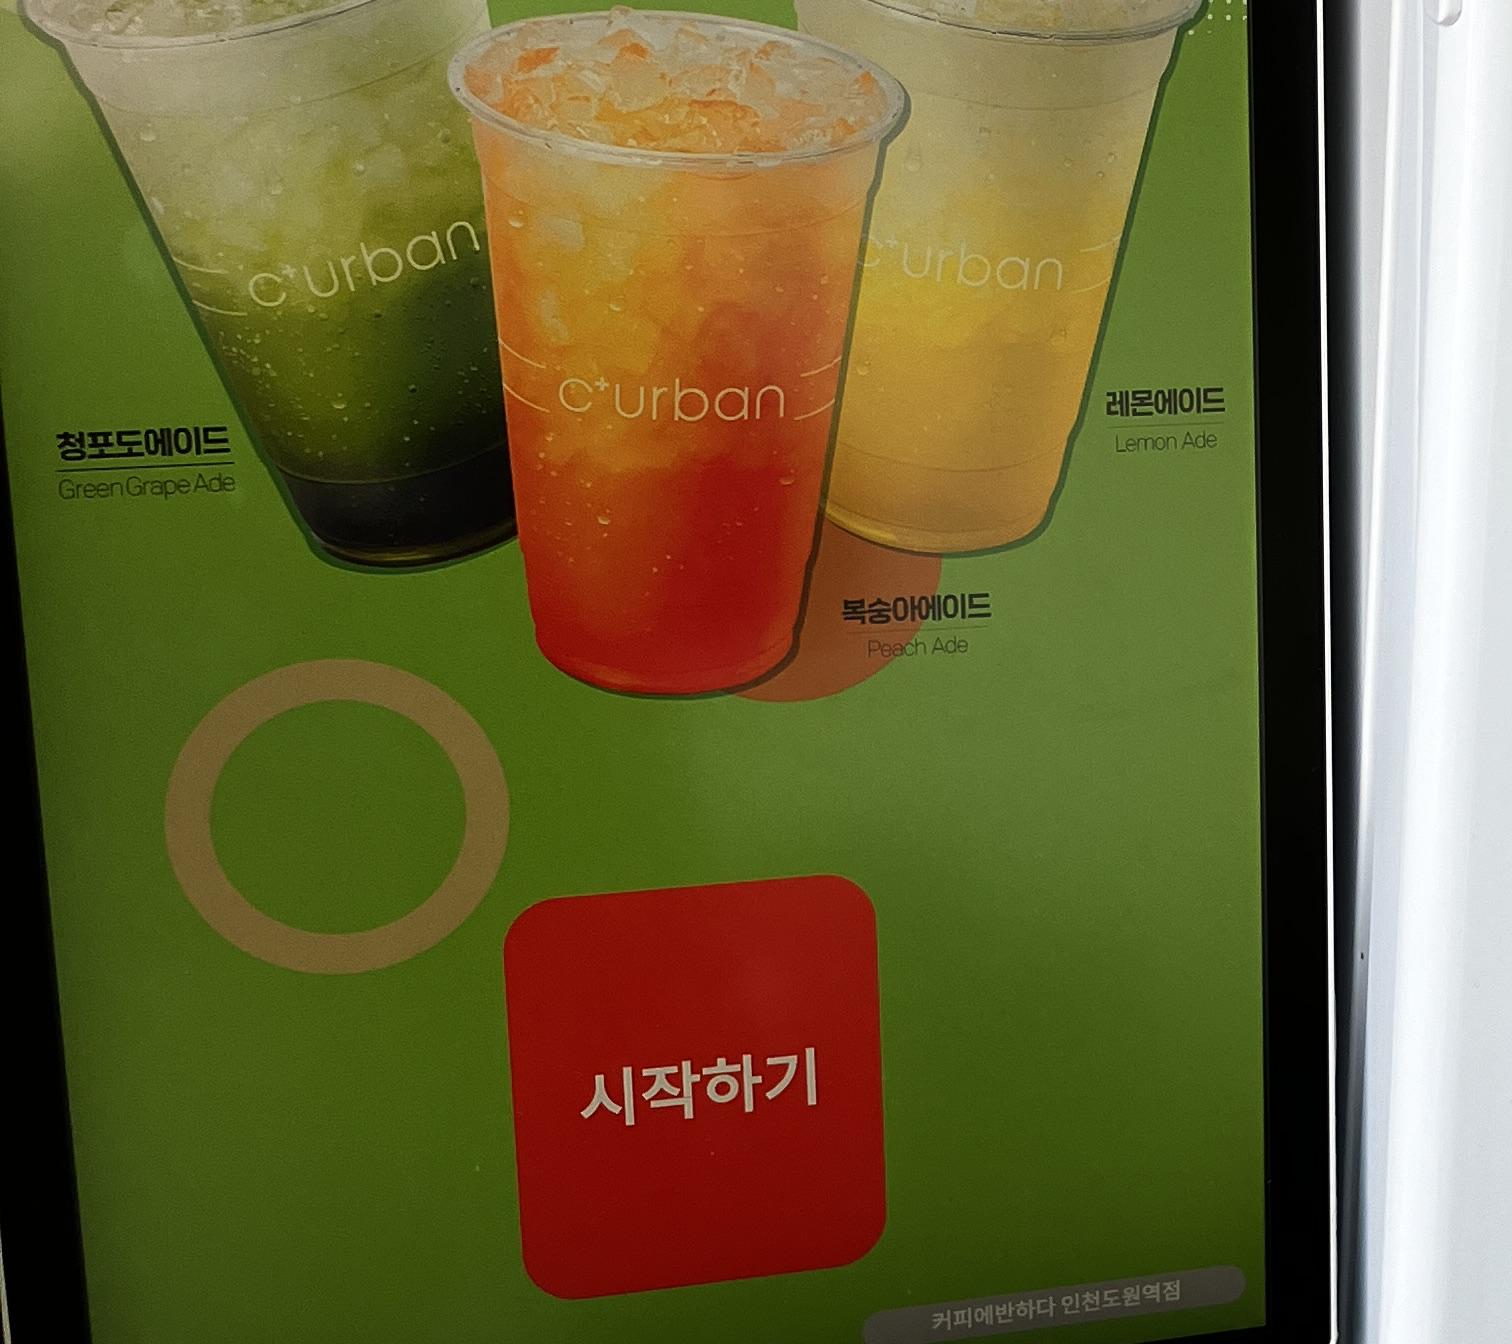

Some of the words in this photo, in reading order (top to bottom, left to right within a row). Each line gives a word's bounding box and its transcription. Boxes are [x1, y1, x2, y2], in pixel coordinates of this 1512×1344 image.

[1104, 386, 1227, 418] 레몬에이드
[56, 426, 232, 462] 청포도에이드
[1114, 430, 1177, 454] Lemon
[1180, 429, 1219, 451] Ade
[58, 475, 124, 501] Green
[125, 474, 191, 502] Grape
[193, 471, 236, 495] Ade
[840, 591, 992, 625] 복숭아에이드
[866, 636, 927, 659] Peach
[931, 634, 970, 656] Ade
[578, 1046, 818, 1126] 시작하기
[930, 1295, 1056, 1333] 커피에반하다
[1059, 1278, 1183, 1318] 인천도원역점
